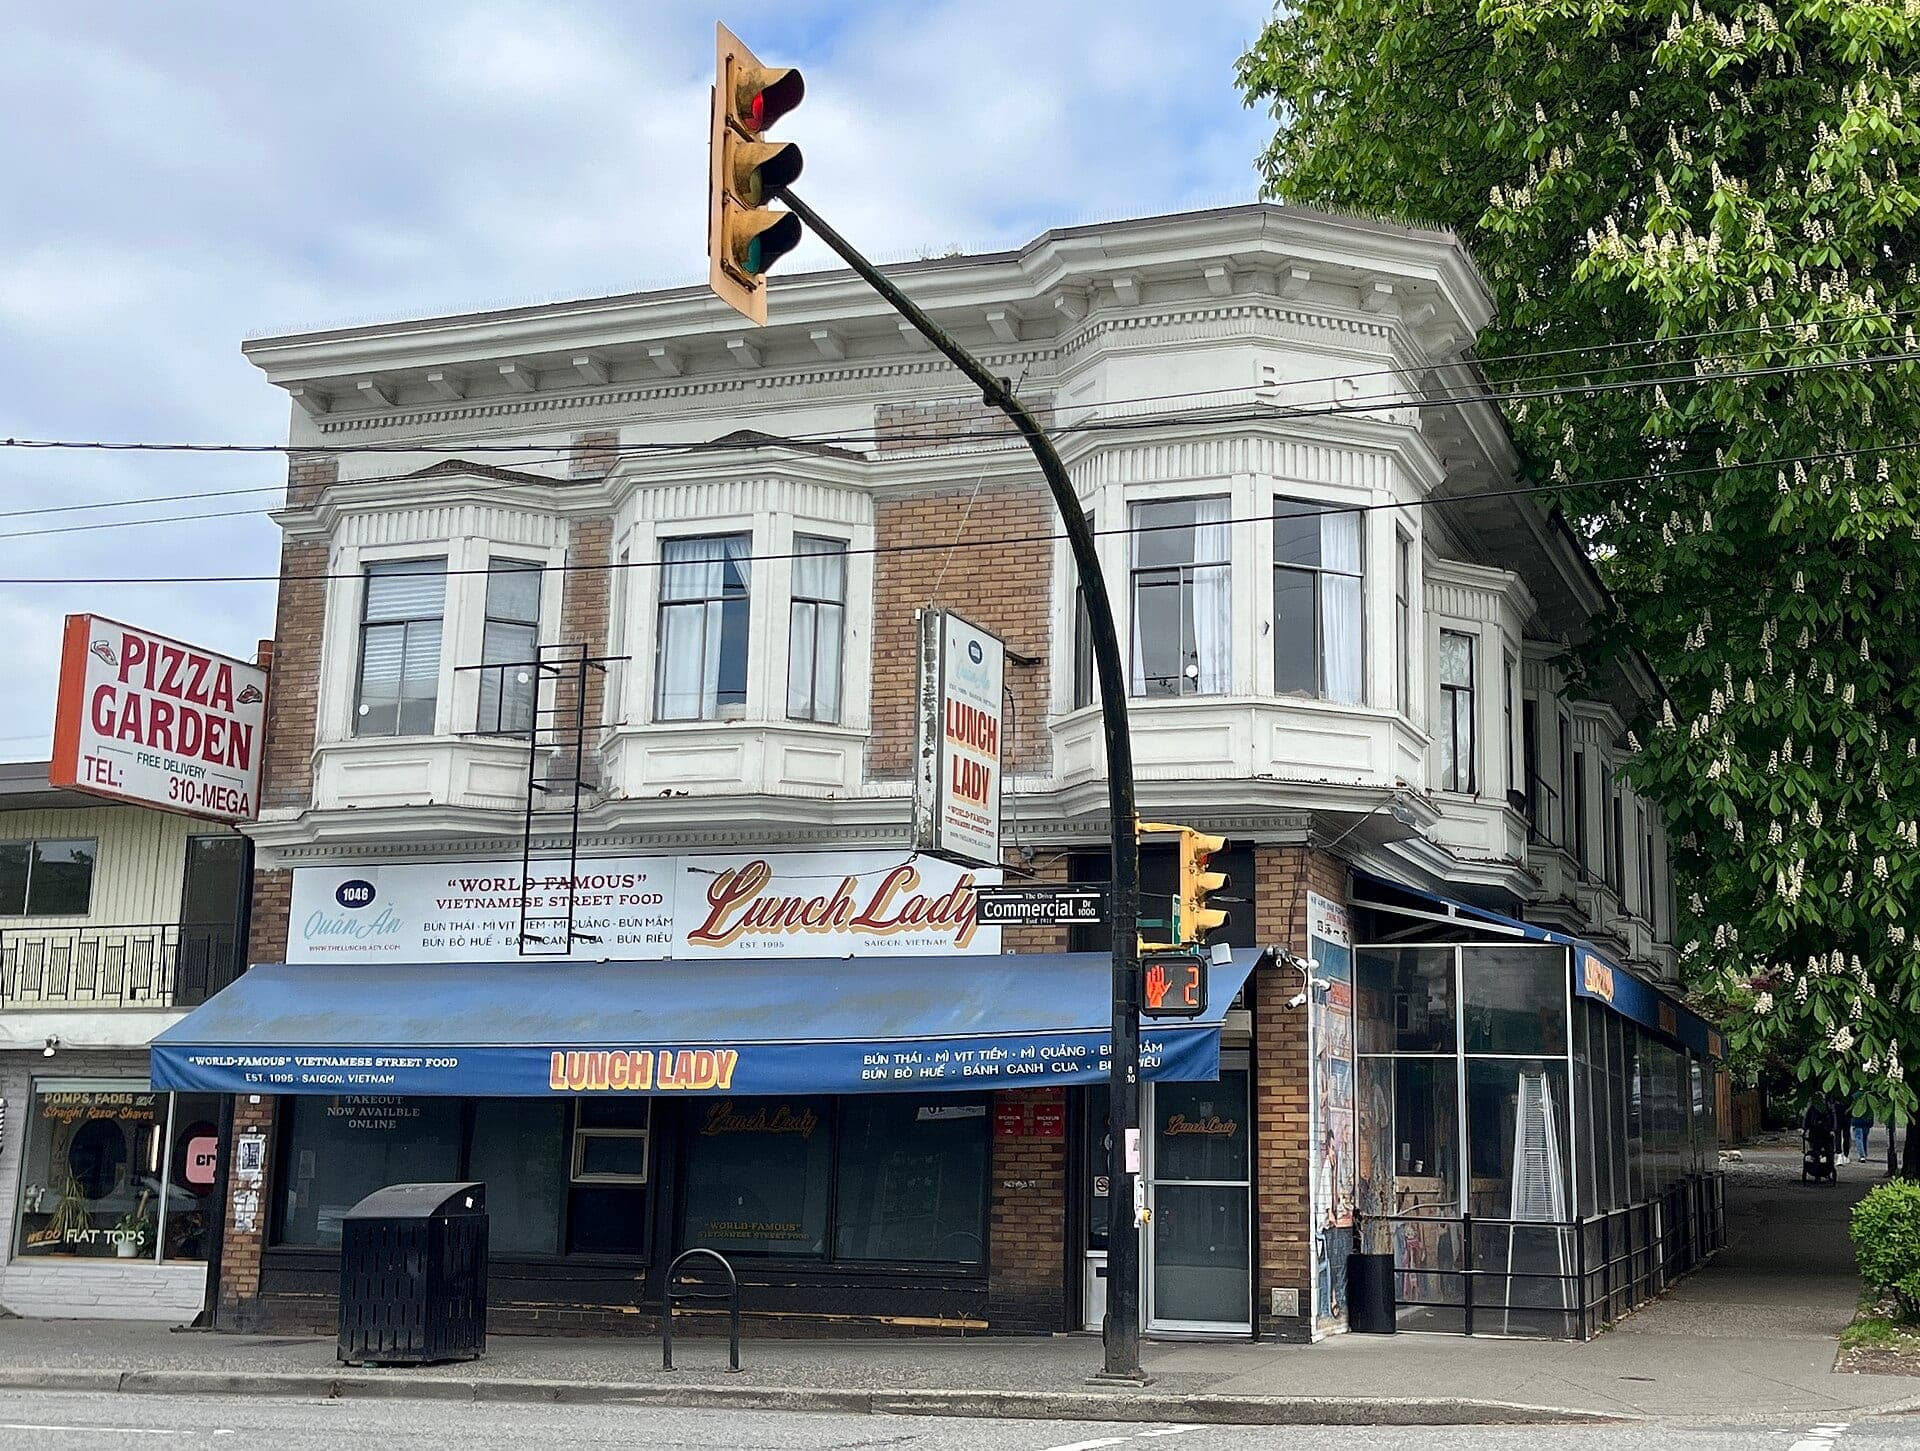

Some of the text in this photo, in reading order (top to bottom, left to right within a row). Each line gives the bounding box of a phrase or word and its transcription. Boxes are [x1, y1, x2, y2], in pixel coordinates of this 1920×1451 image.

[117, 632, 235, 713] PIZZA
[91, 684, 254, 771] GARDEN
[945, 697, 998, 760] LUNCH
[84, 755, 124, 788] TEL:
[136, 752, 207, 779] FREE DELIVERY
[952, 754, 991, 810] LADY
[168, 776, 250, 816] 310-MEGA
[436, 893, 663, 910] VIETNAMESE STREET FOOD
[687, 860, 977, 949] Lunch Lady
[984, 899, 1092, 917] Commercial Dr
[1078, 908, 1096, 916] 1000
[905, 938, 948, 946] VIETNAM
[1183, 965, 1199, 1005] 2
[188, 1056, 458, 1068] "WORLD-FAMOUS" VIETNAMESE STREET FOOD
[863, 1052, 889, 1065] BÚN
[894, 1051, 922, 1064] THÁI
[935, 1049, 950, 1062] MÌ
[954, 1051, 974, 1063] VỊT
[1020, 1045, 1035, 1058] MÌ
[1041, 1043, 1086, 1059] QUẢNG
[245, 1073, 267, 1082] EST.
[348, 1074, 395, 1083] VIETNAM
[549, 1050, 739, 1090] LUNCH LADY
[862, 1066, 889, 1080] BÚN
[894, 1066, 912, 1079] BÒ
[919, 1064, 945, 1077] HUẾ
[963, 1062, 999, 1076] BÁNH
[1006, 1063, 1044, 1074] CANH
[1051, 1061, 1079, 1073] CUA
[95, 1093, 133, 1105] FADES
[345, 1095, 404, 1104] TAKEOUT
[43, 1105, 154, 1124] Straight Razor Shaves
[327, 1107, 420, 1117] NOW AVAILBLE
[348, 1119, 397, 1129] ONLINE
[28, 1229, 61, 1243] WE DO
[66, 1228, 145, 1246] FLAT TOPS
